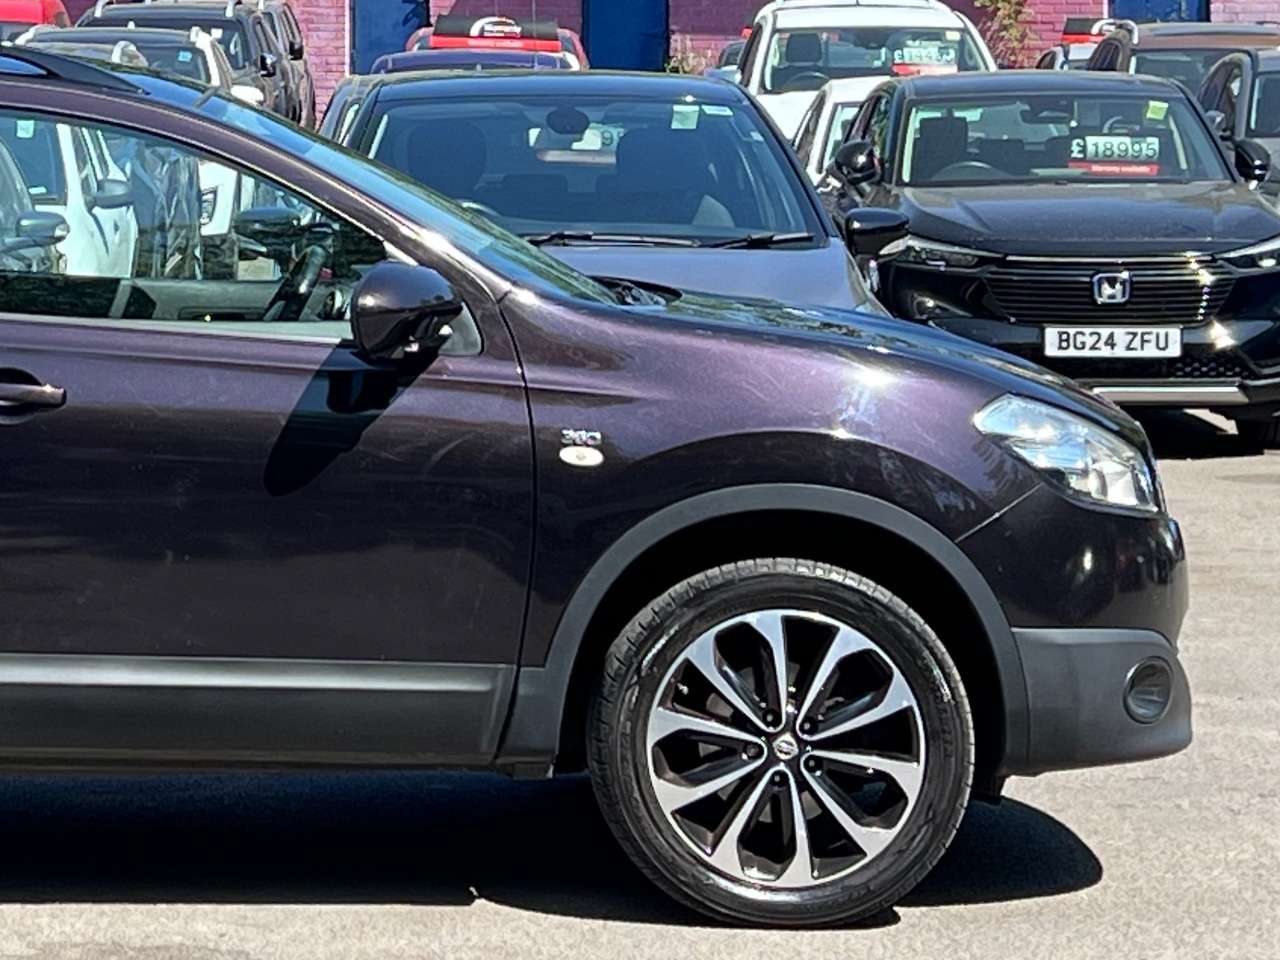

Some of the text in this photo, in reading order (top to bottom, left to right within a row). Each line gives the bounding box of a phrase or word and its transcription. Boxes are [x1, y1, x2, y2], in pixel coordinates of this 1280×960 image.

[1070, 138, 1158, 159] £18995
[1057, 331, 1169, 352] BG24 ZFU
